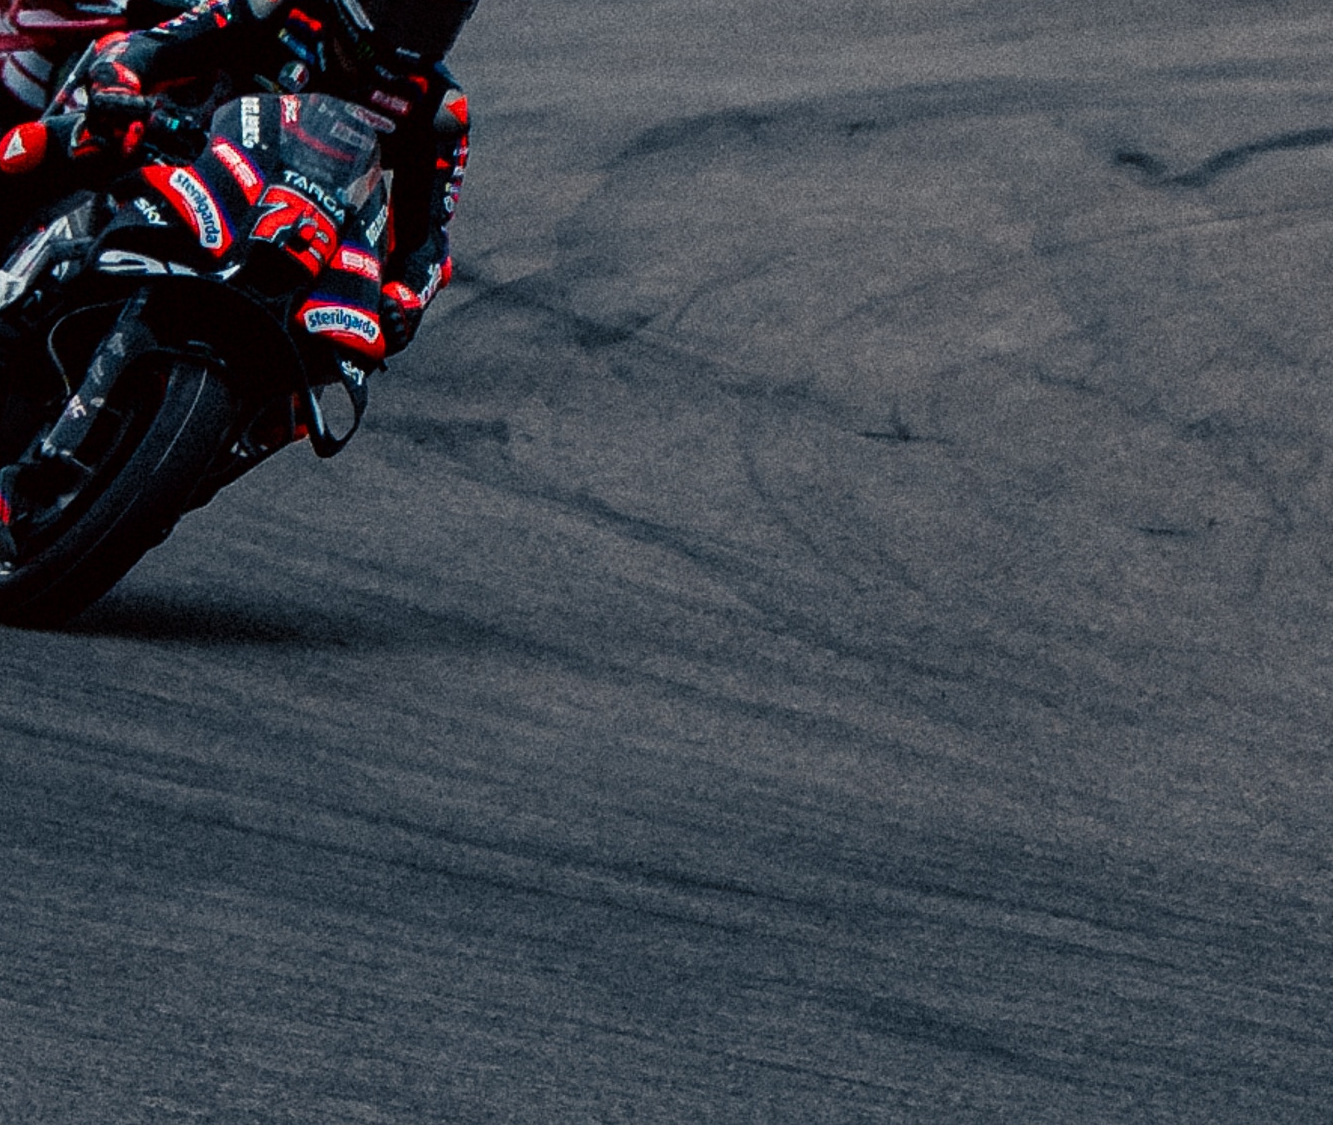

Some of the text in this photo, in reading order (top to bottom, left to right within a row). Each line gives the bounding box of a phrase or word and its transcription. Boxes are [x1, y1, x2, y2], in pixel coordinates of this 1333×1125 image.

[133, 196, 168, 226] sky
[173, 172, 222, 246] sterilgarda
[283, 169, 346, 223] TARGA
[307, 310, 377, 338] sterilgarda
